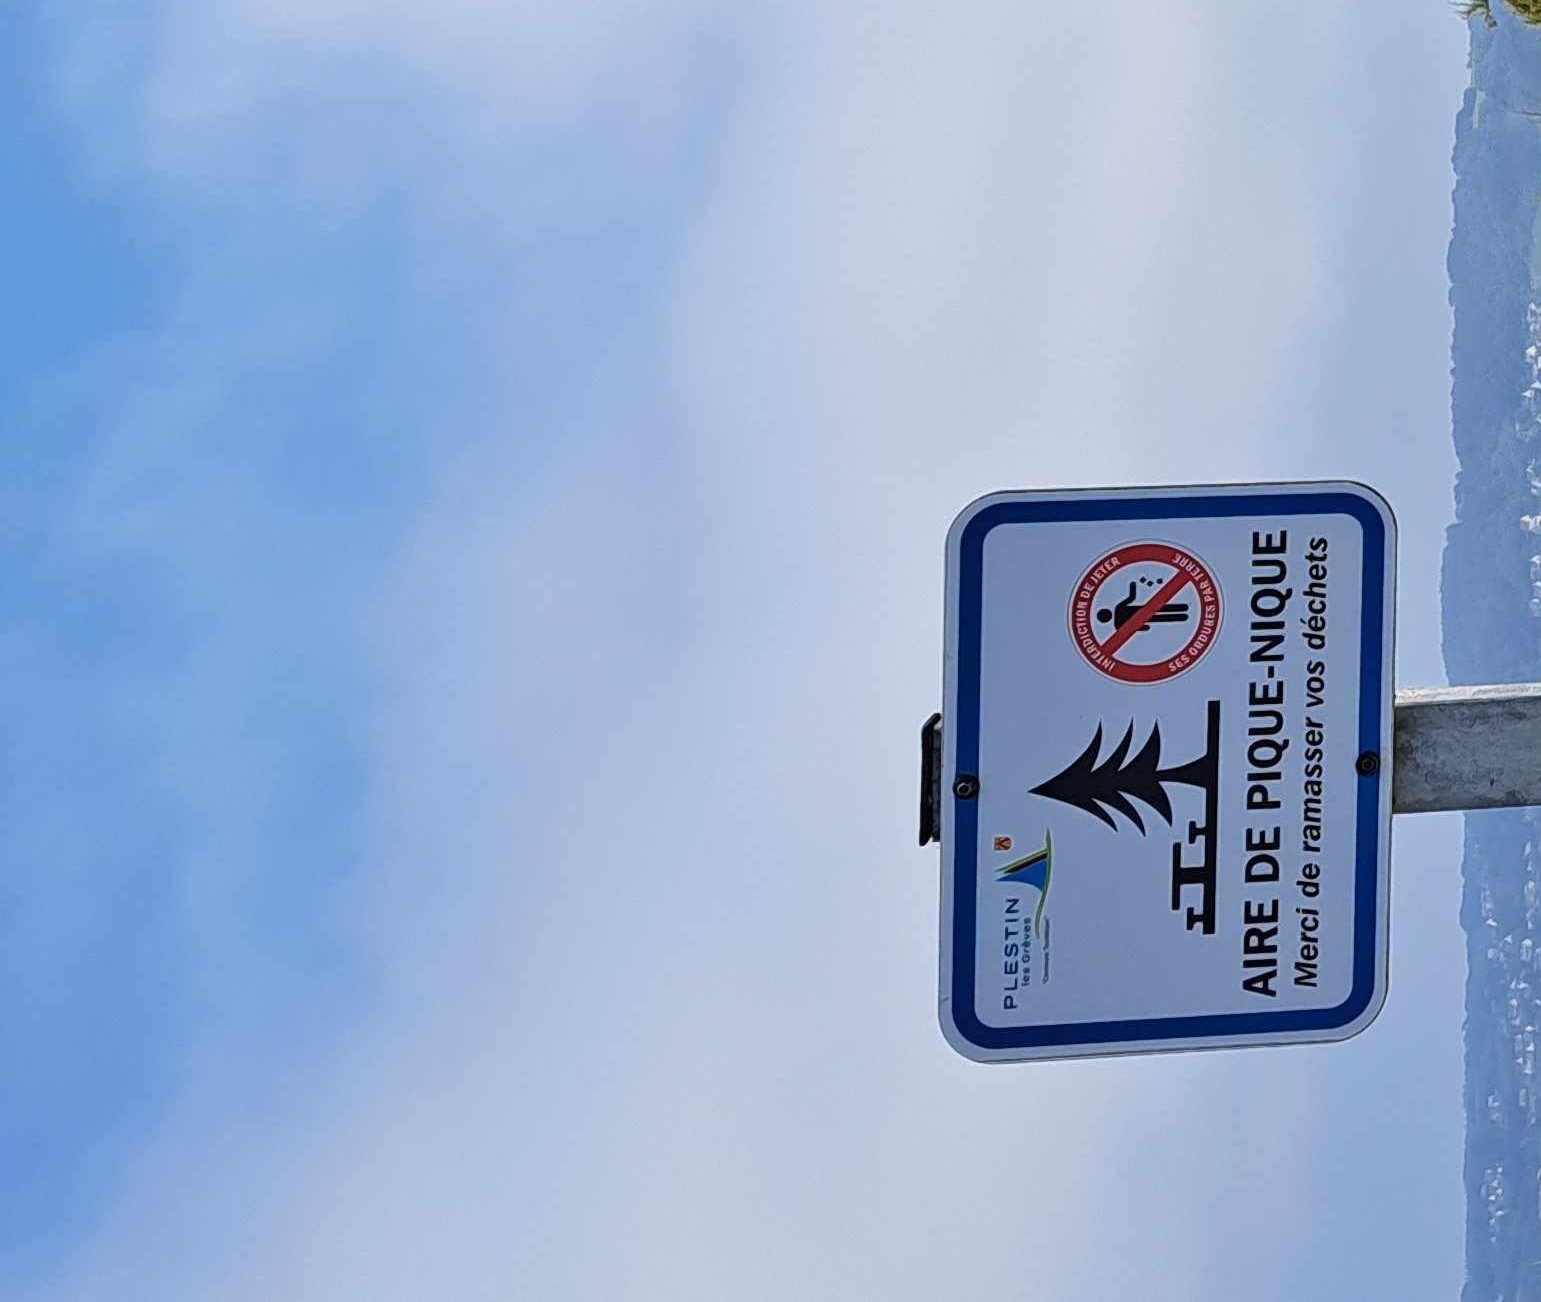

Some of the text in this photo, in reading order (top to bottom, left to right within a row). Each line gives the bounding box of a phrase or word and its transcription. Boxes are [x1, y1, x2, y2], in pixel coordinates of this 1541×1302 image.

[1075, 556, 1121, 672] INTERDICTION DE JETER
[1167, 553, 1216, 672] SES ORDURES PAR TERRE
[1242, 530, 1293, 997] AIRE DE PIQUE-NIQUE
[1294, 536, 1328, 987] Merci de ramasser vos déchets
[1003, 898, 1020, 1010] PLESTIN
[1021, 917, 1032, 987] les Grèves
